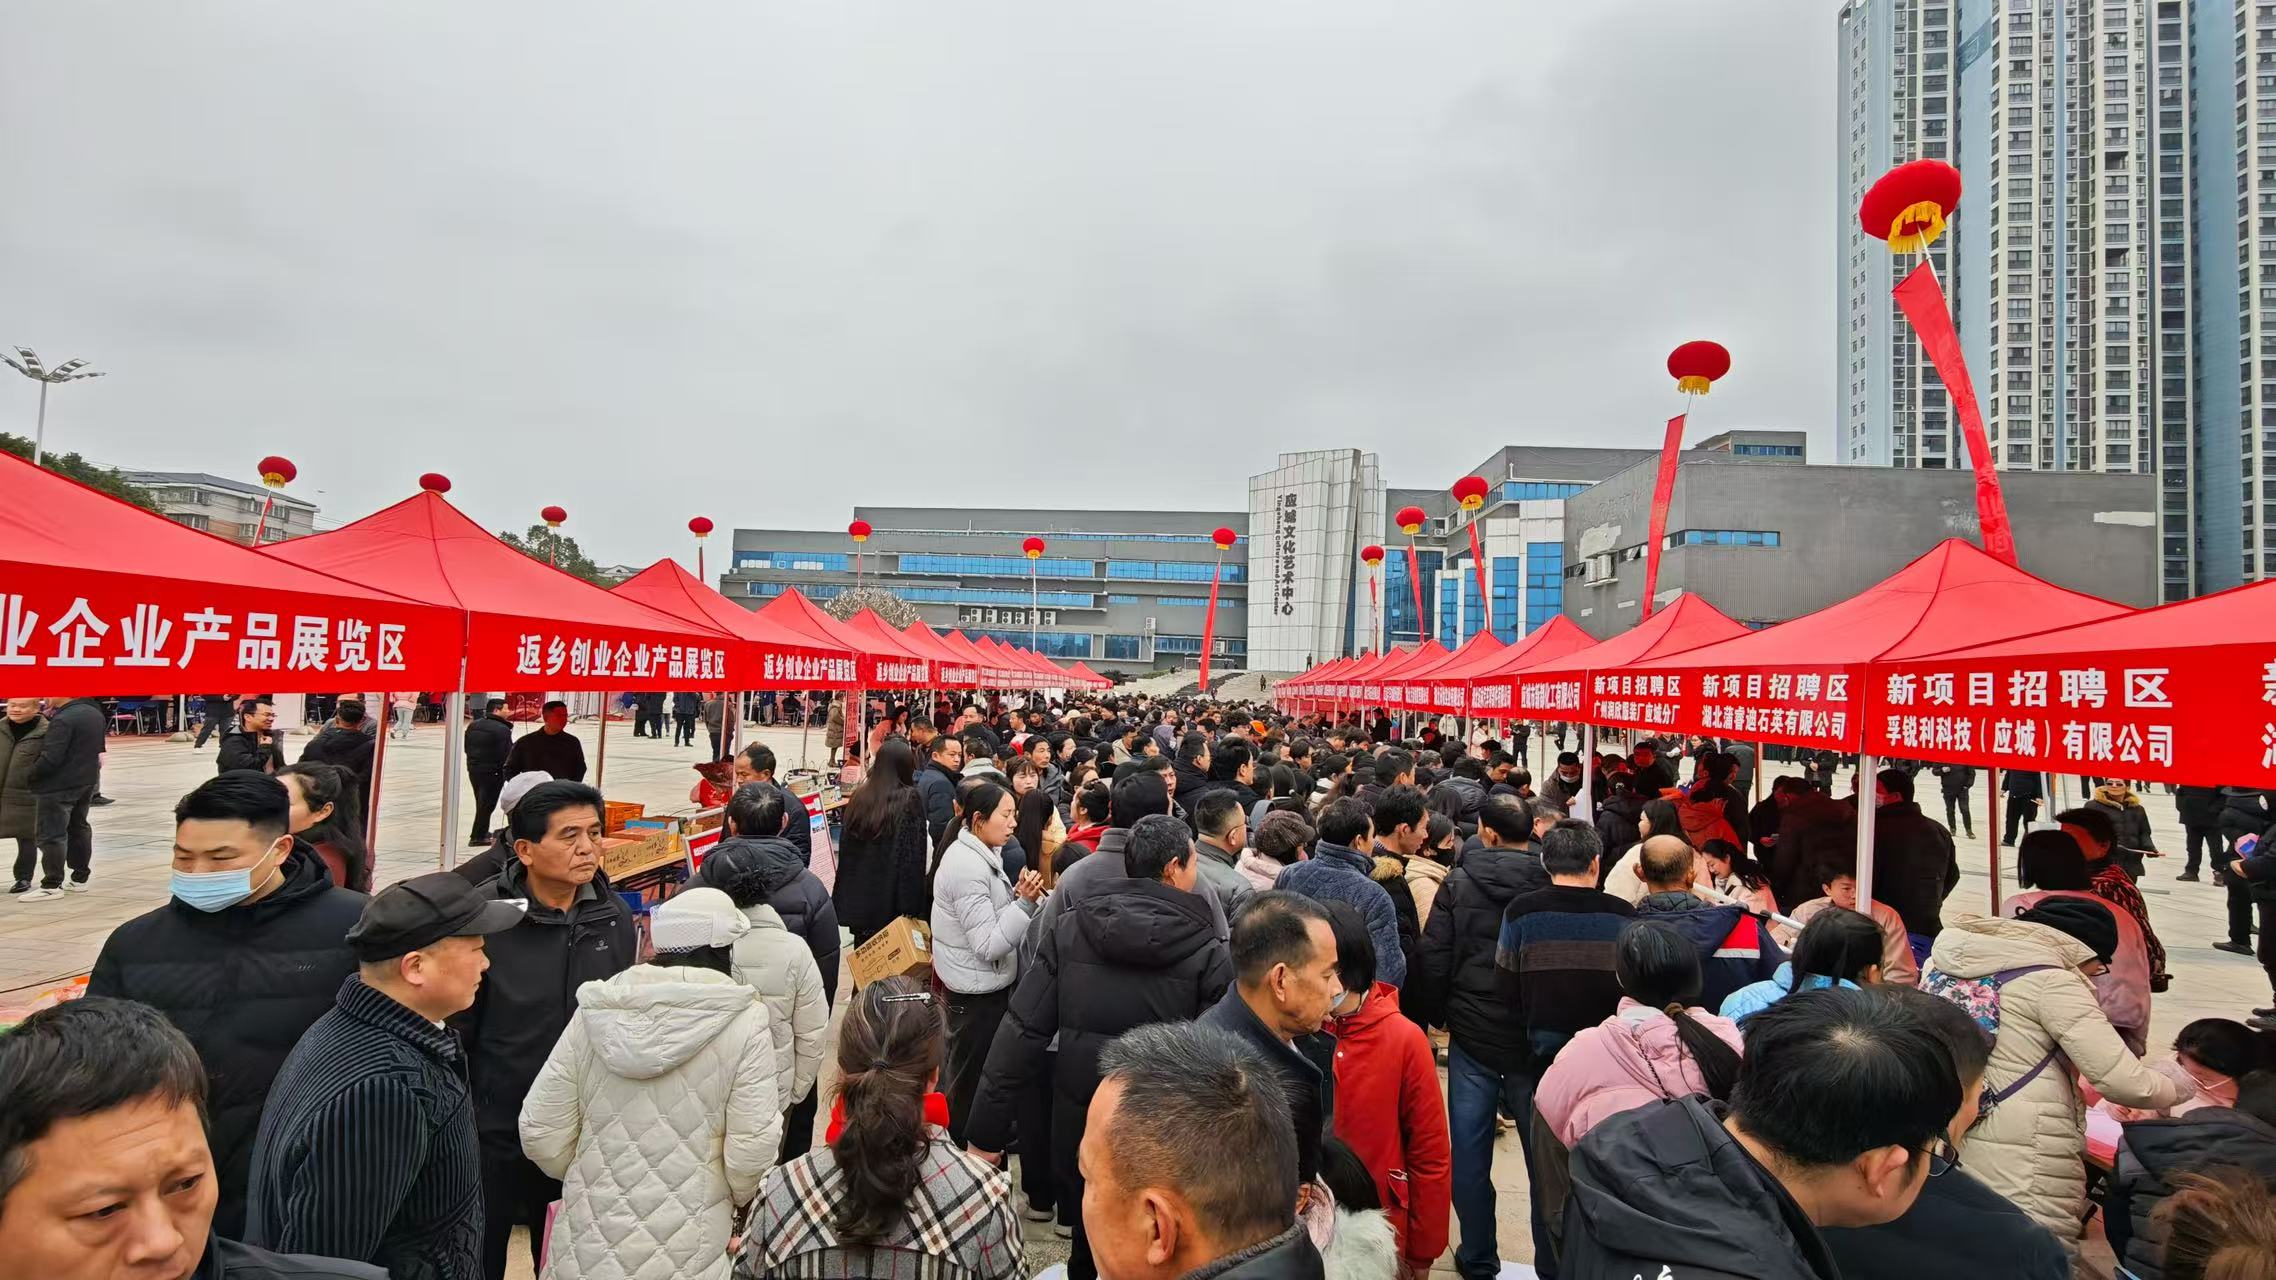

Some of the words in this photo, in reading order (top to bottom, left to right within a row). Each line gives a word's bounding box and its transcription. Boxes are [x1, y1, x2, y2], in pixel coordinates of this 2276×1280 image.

[1281, 493, 1297, 616] 应城文化艺术中心
[516, 633, 726, 679] 返乡创业企业产品展览区
[763, 653, 857, 682] 返乡创业企业产品展览区
[1594, 674, 1681, 697] 新项目招聘区
[1702, 673, 1849, 701] 新项目招聘区
[1886, 667, 2173, 708] 新项目招聘区
